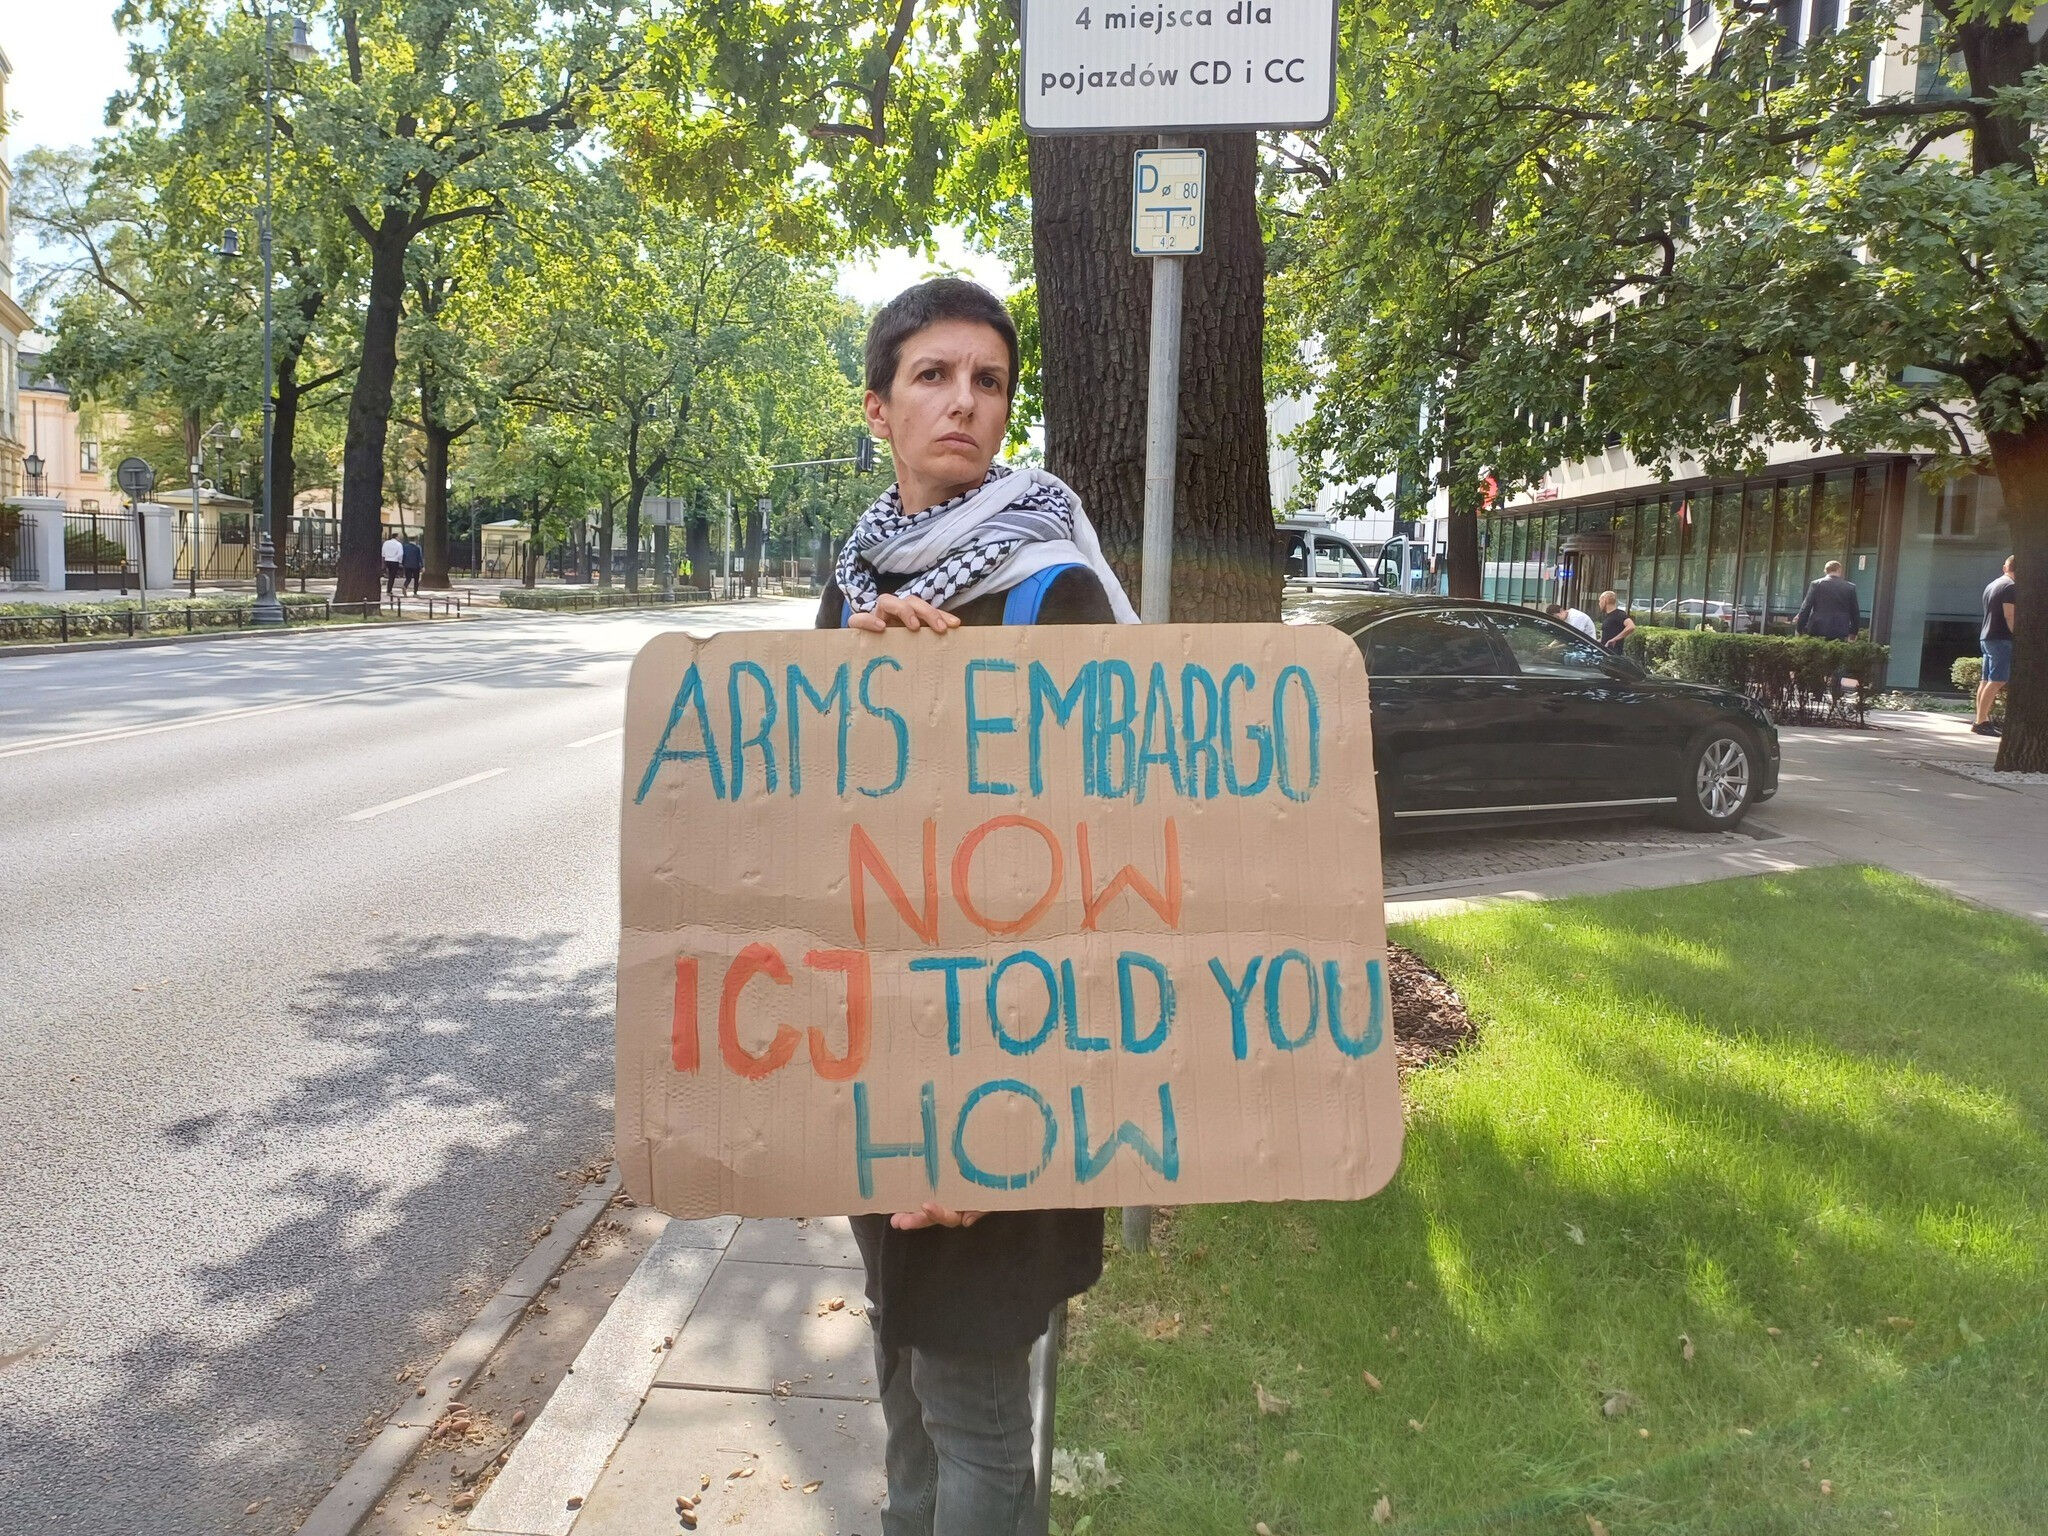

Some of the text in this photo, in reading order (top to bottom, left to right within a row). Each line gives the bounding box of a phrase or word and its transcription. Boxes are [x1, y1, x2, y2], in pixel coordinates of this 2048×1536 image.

[1075, 1, 1272, 35] 4 miejsca dla
[1041, 58, 1305, 96] pojazdów CD i CC
[1139, 165, 1159, 193] D
[1183, 183, 1199, 199] 80
[634, 655, 1320, 804] ARMS EMBARGO
[848, 814, 1182, 945] NOW
[671, 942, 1383, 1081] ICJ TOLD YOU
[855, 1078, 1180, 1199] HOW
